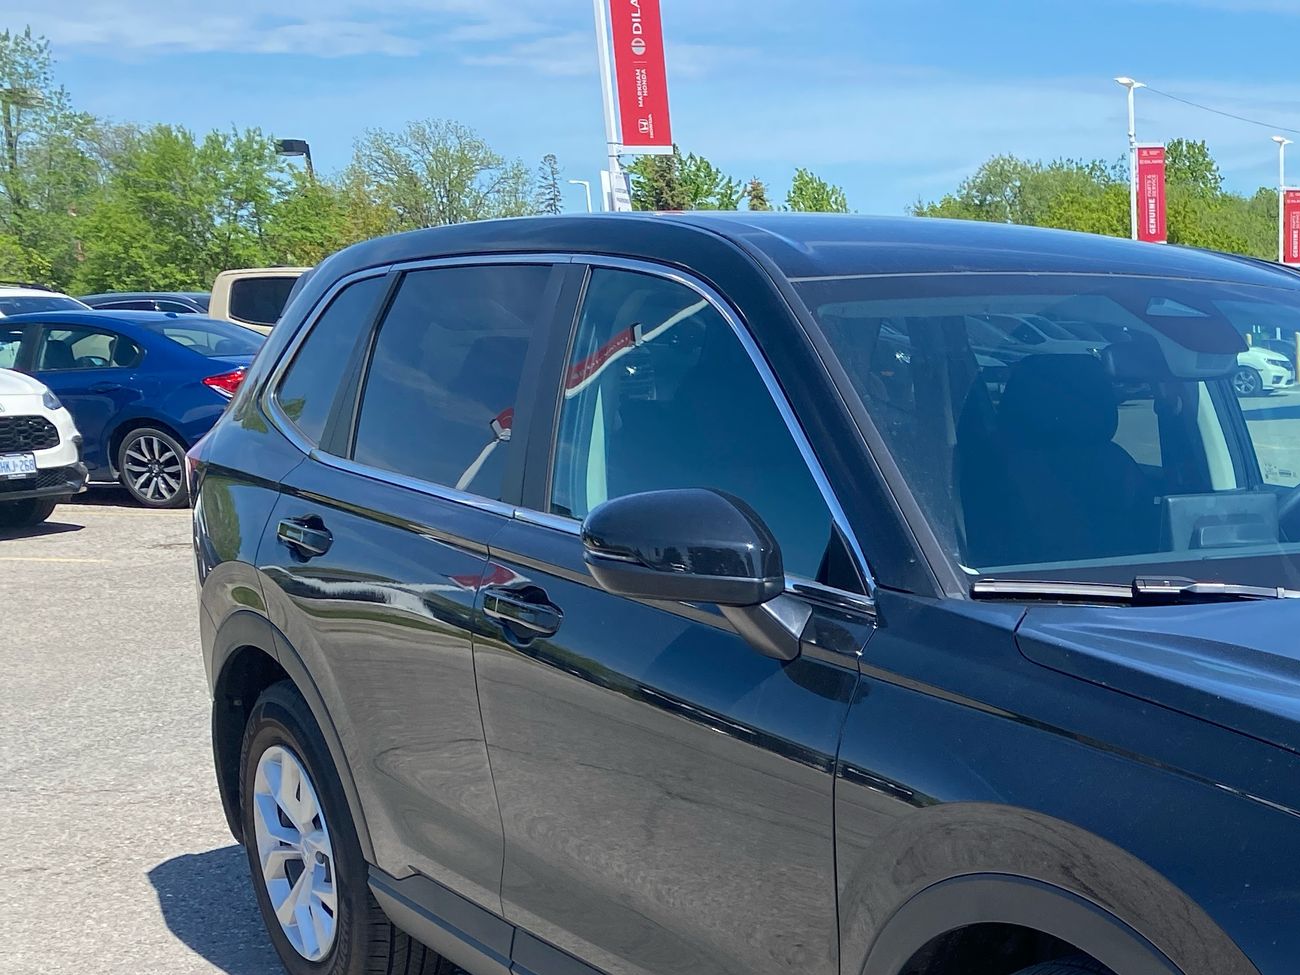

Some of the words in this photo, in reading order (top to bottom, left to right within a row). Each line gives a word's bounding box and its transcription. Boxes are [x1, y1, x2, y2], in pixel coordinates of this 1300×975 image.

[635, 68, 643, 108] MARKHAM
[1148, 198, 1156, 235] GENUINE
[19, 459, 35, 472] 268
